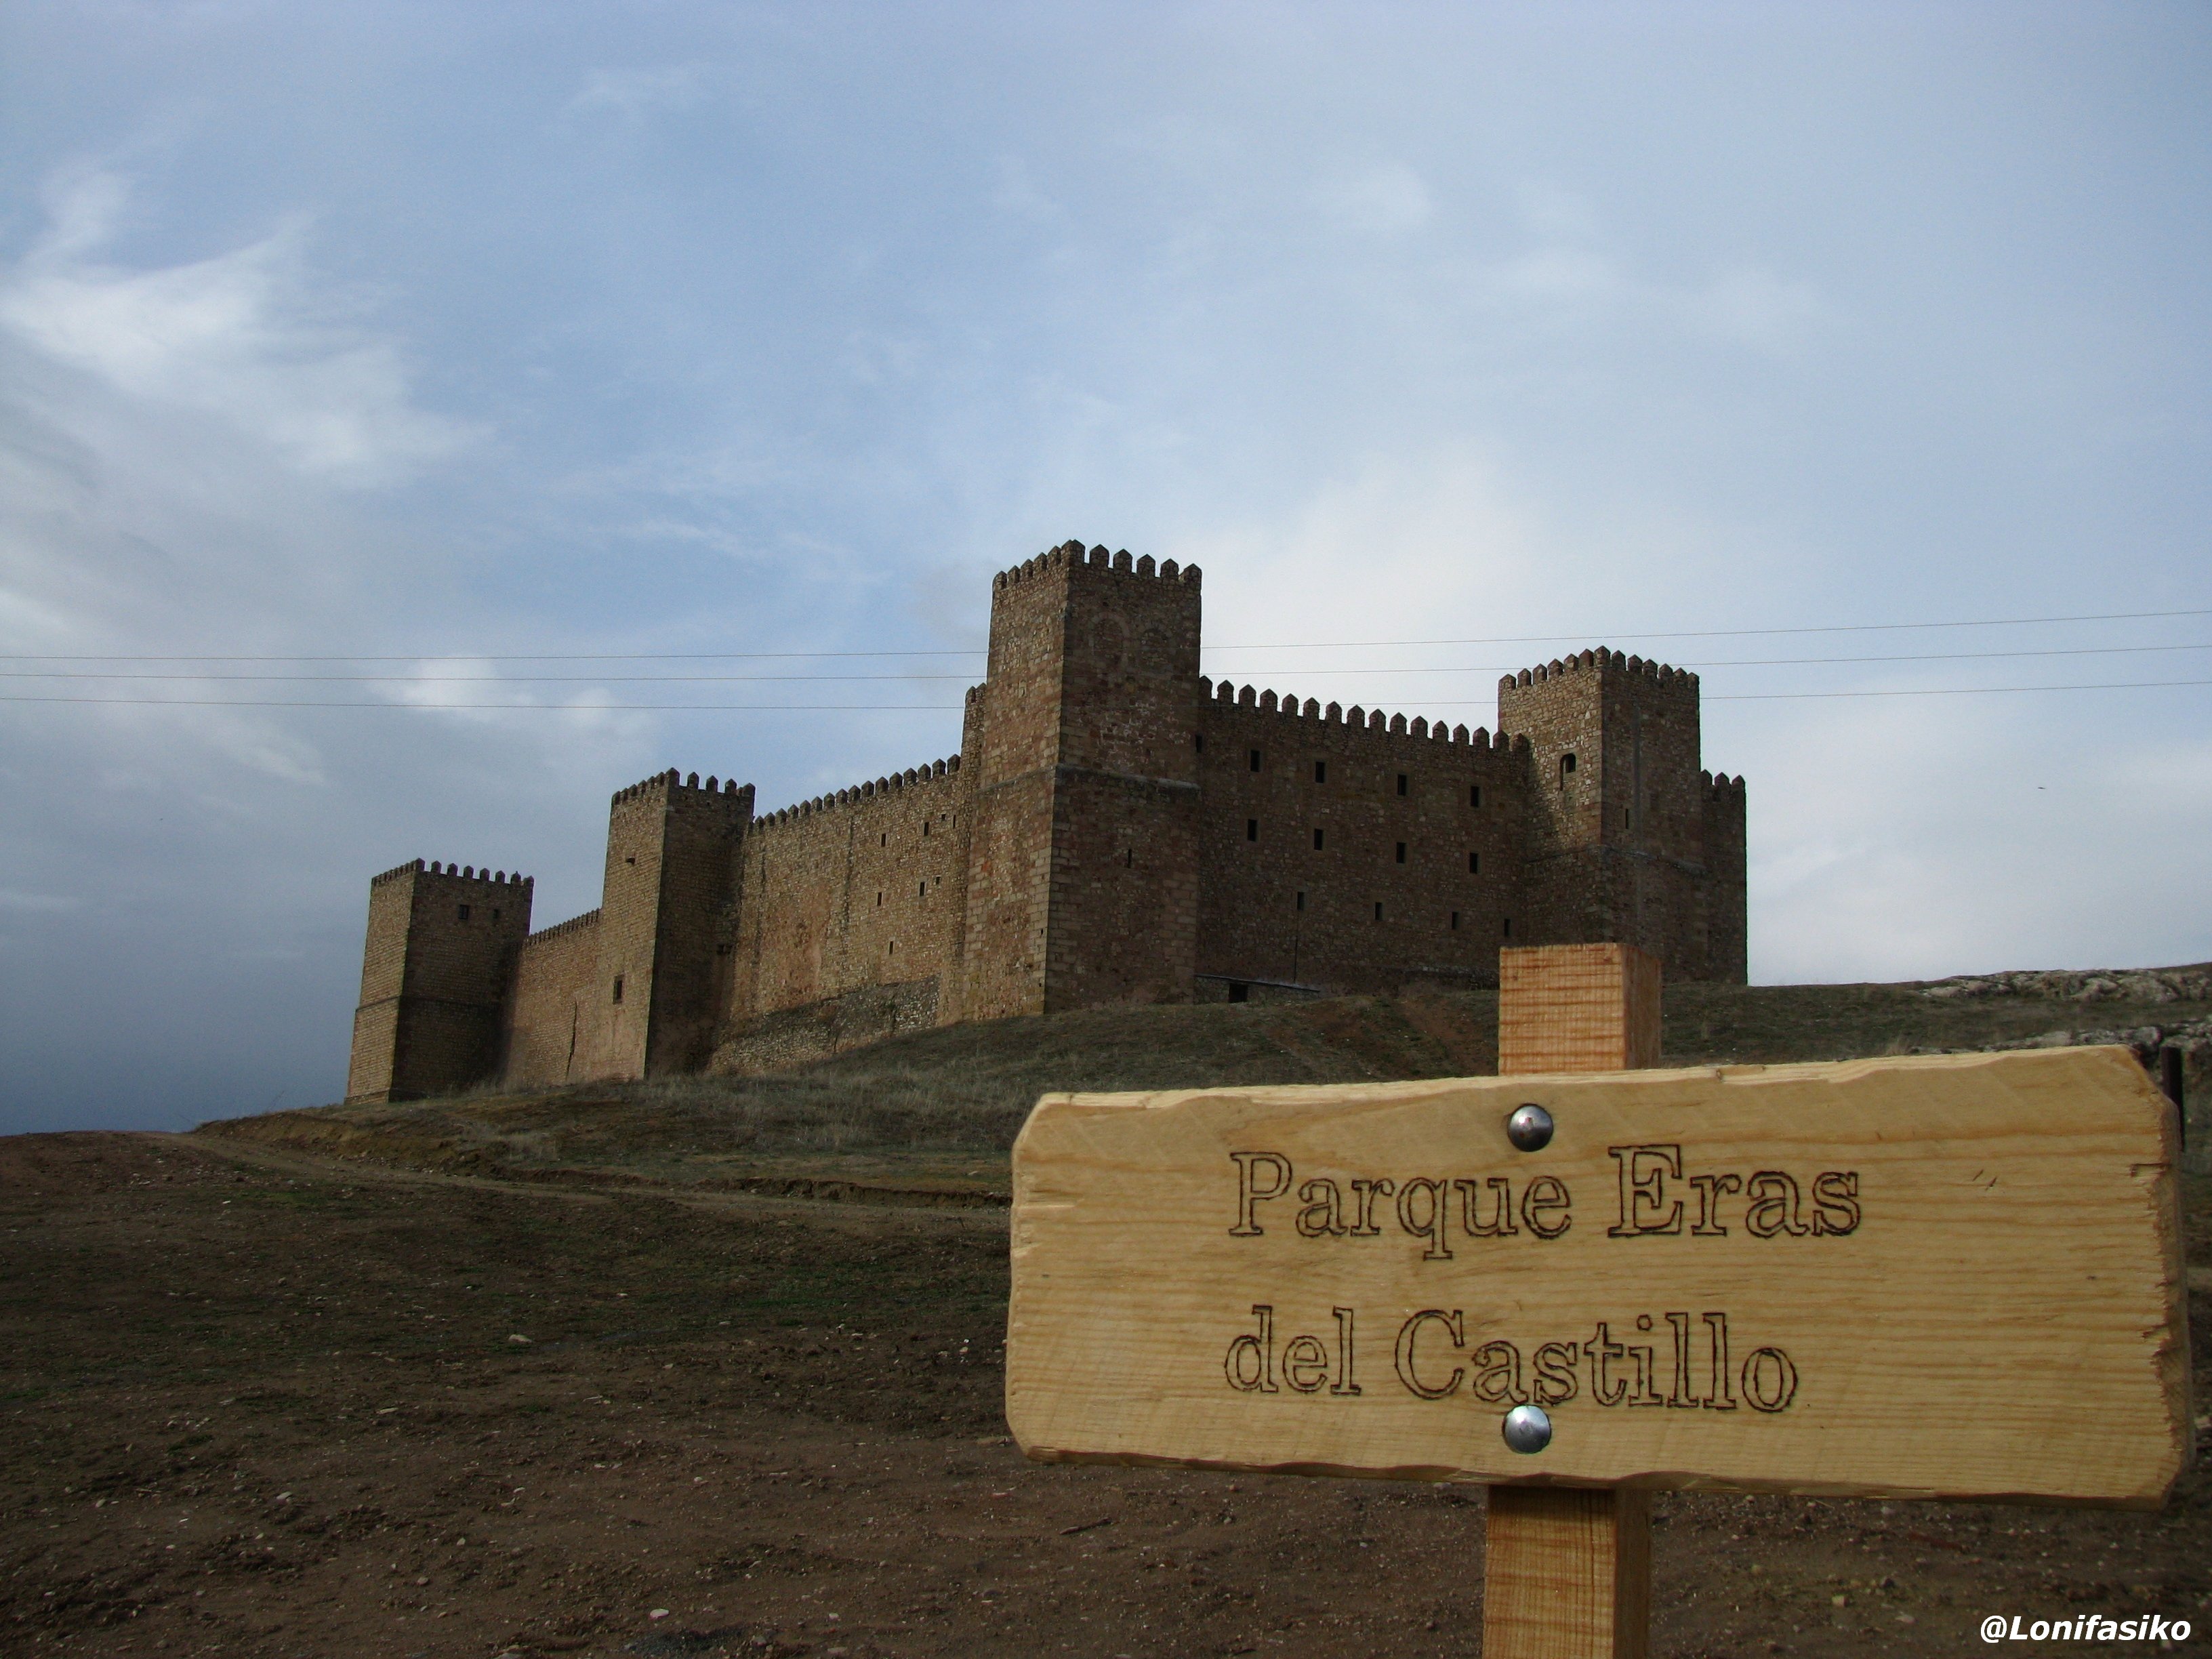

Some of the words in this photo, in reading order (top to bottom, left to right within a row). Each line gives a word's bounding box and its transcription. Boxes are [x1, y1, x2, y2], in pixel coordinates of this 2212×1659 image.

[1229, 1151, 1572, 1261] Parque
[1607, 1144, 1862, 1239] Eras
[1224, 1305, 1361, 1397] del
[1394, 1309, 1799, 1413] Castillo
